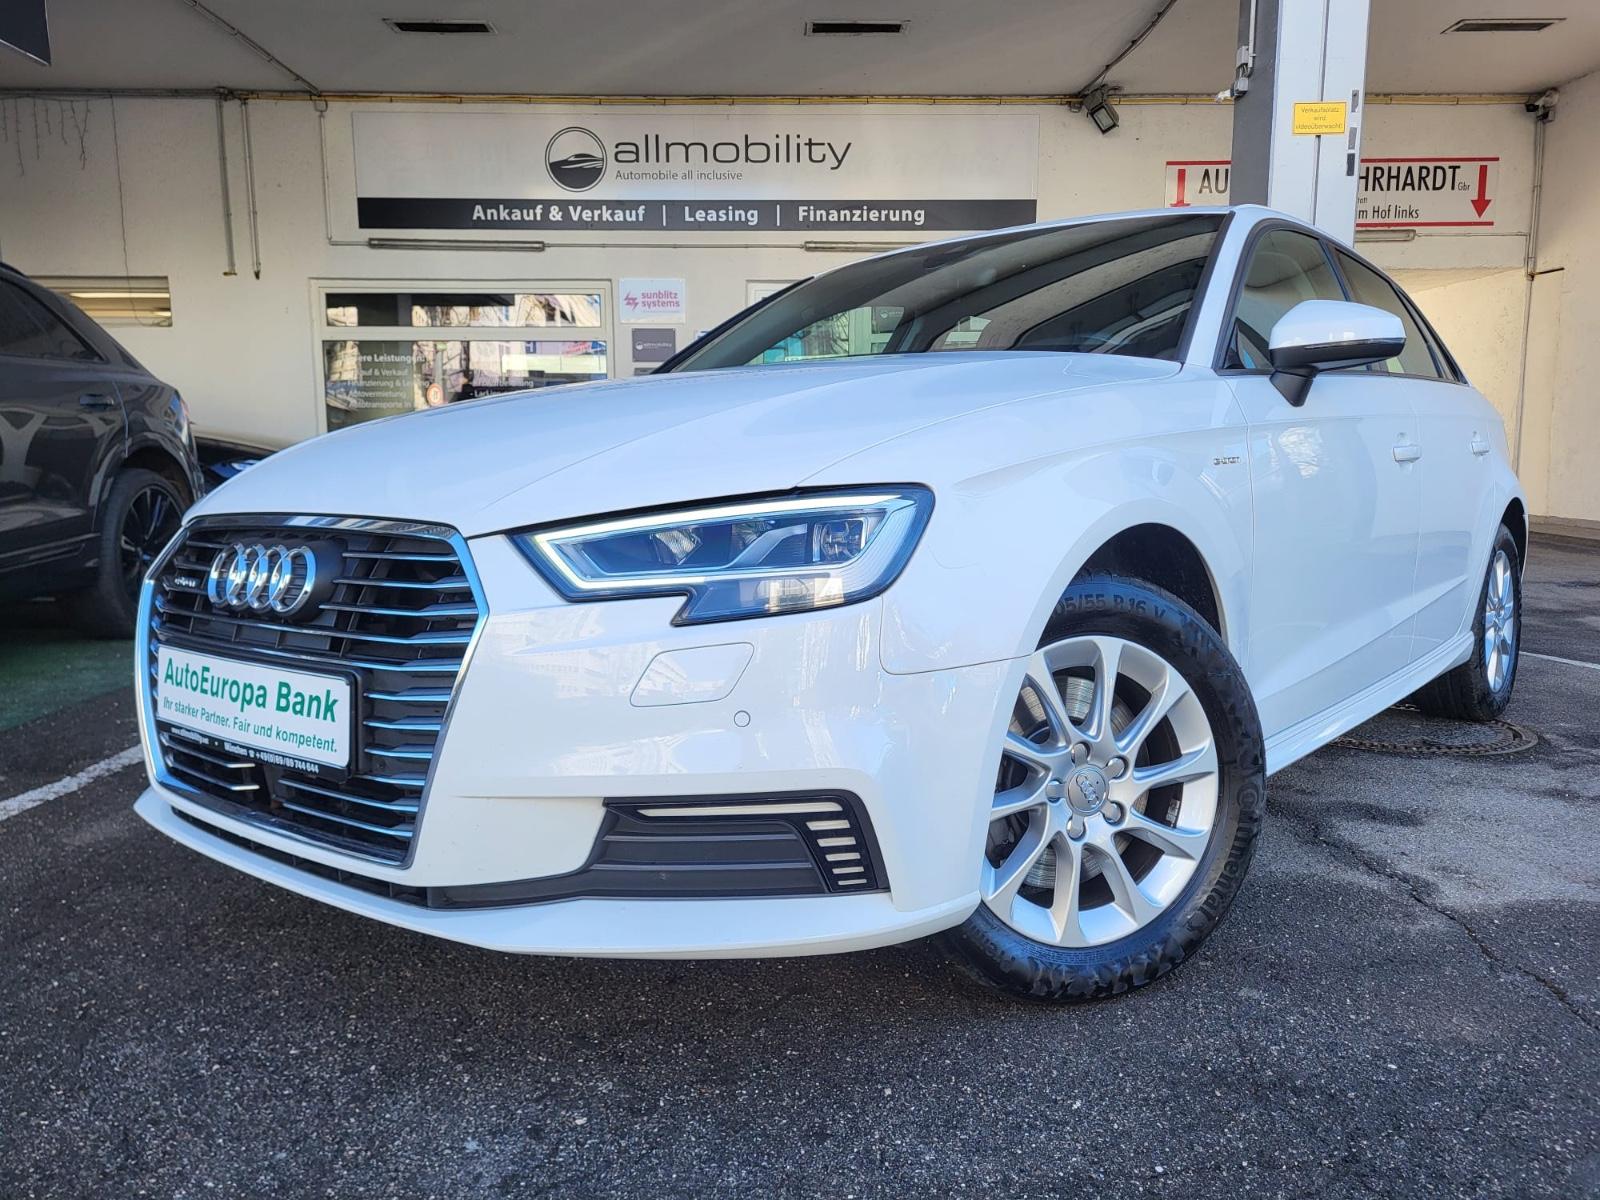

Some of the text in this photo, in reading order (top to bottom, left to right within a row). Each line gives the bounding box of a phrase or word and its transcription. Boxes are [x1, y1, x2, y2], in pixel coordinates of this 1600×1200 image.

[614, 133, 852, 170] allmobility
[615, 170, 743, 181] Automobile all inclusive
[1198, 165, 1471, 194] AU HRHARDT Gbr
[472, 205, 926, 226] Ankauf & Verkauf Leasing Finanzierung
[1358, 204, 1420, 220] m Hof links
[641, 291, 679, 299] sunblitz
[641, 300, 681, 309] systems
[359, 354, 373, 362] ere
[164, 657, 339, 723] AutoEuropa Bank
[163, 696, 338, 753] Ihr starker Partner. Fair und kompetent.
